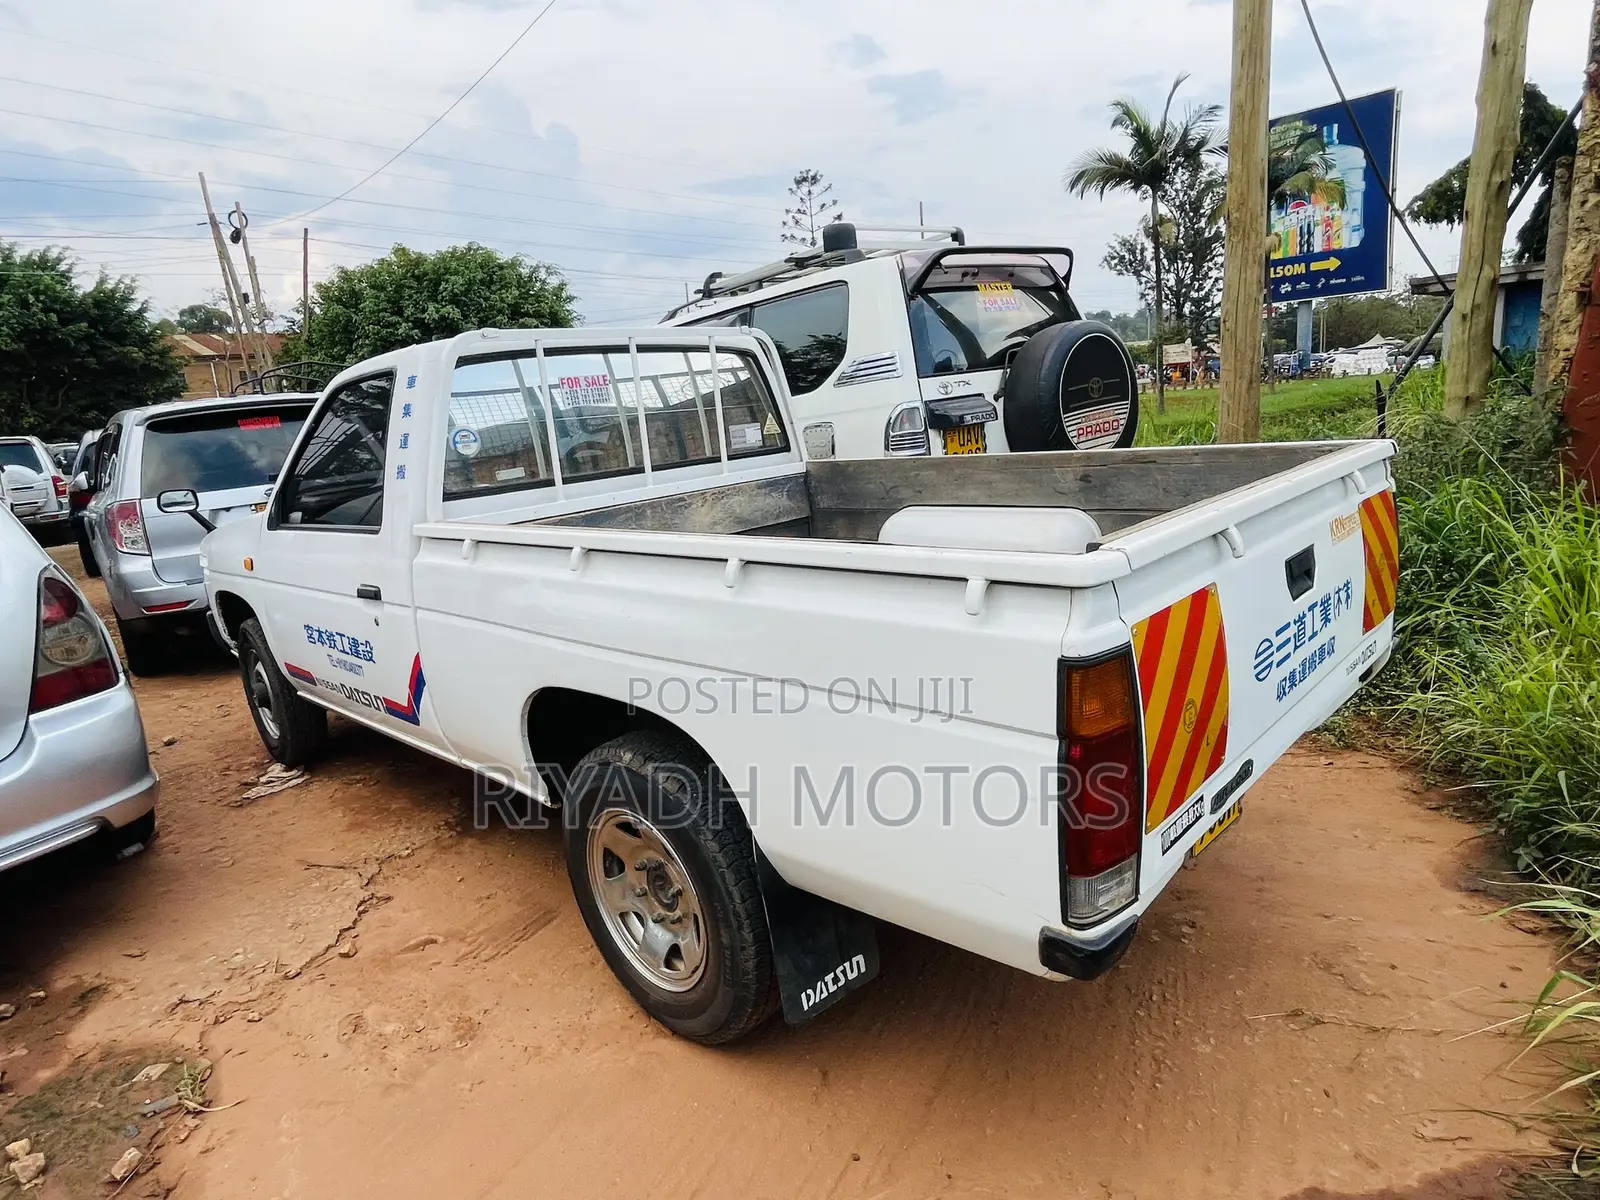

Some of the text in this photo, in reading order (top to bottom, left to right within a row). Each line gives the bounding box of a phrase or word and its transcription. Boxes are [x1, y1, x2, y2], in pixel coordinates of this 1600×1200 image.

[560, 375, 609, 389] FOR SALE
[954, 380, 972, 388] TX
[971, 412, 996, 422] PRADO
[1077, 419, 1120, 440] PRADO
[800, 953, 867, 1012] DATSUN
